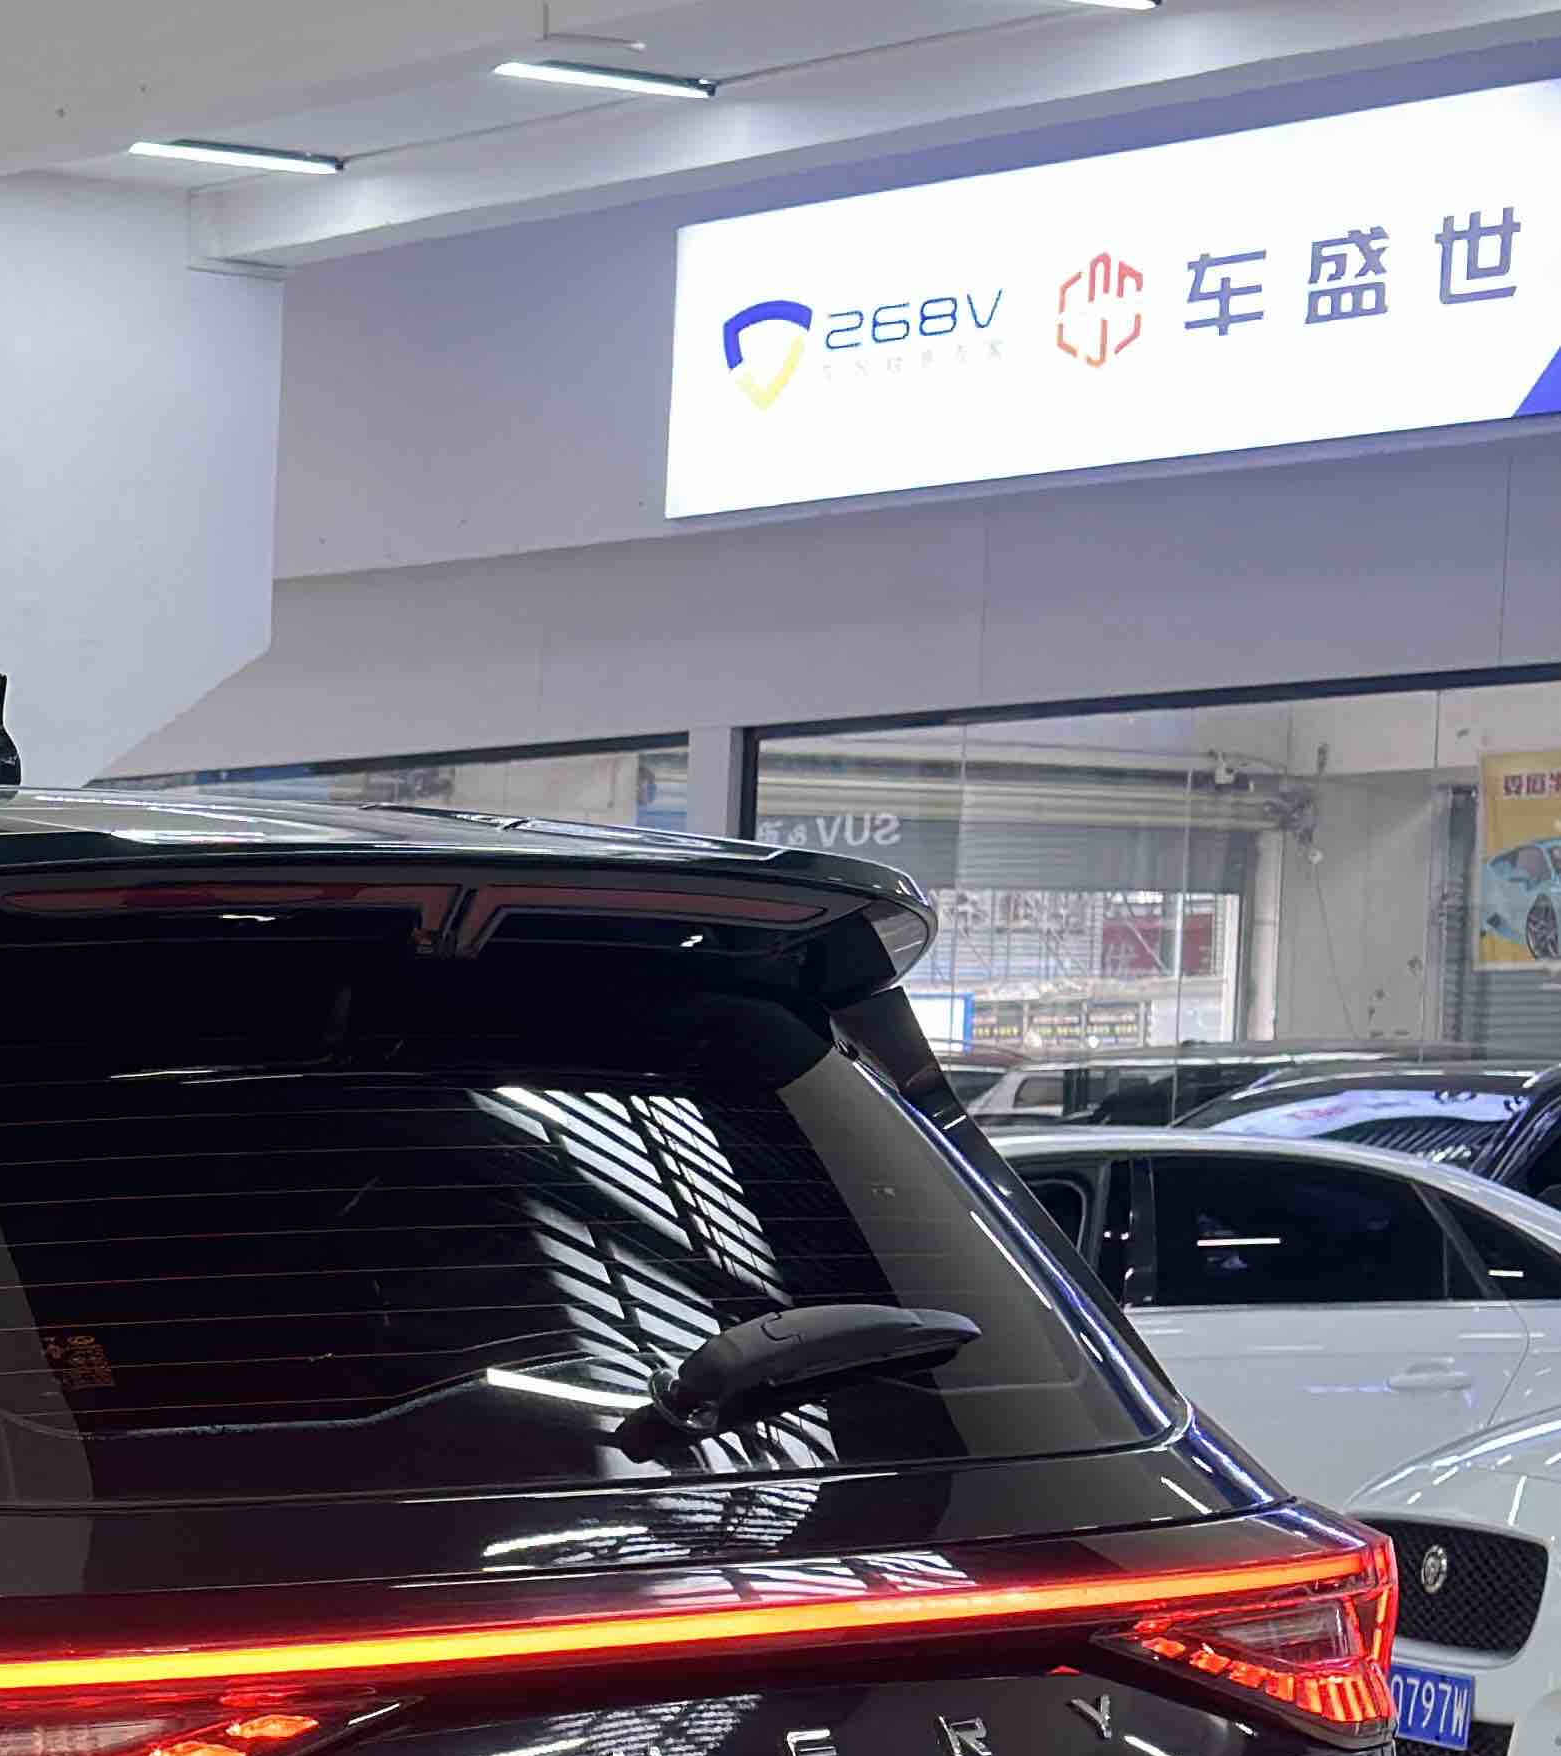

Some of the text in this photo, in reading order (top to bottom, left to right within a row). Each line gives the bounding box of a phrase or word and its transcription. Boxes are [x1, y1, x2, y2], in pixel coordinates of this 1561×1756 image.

[825, 288, 1004, 350] 268V
[1183, 207, 1522, 336] 车盛世
